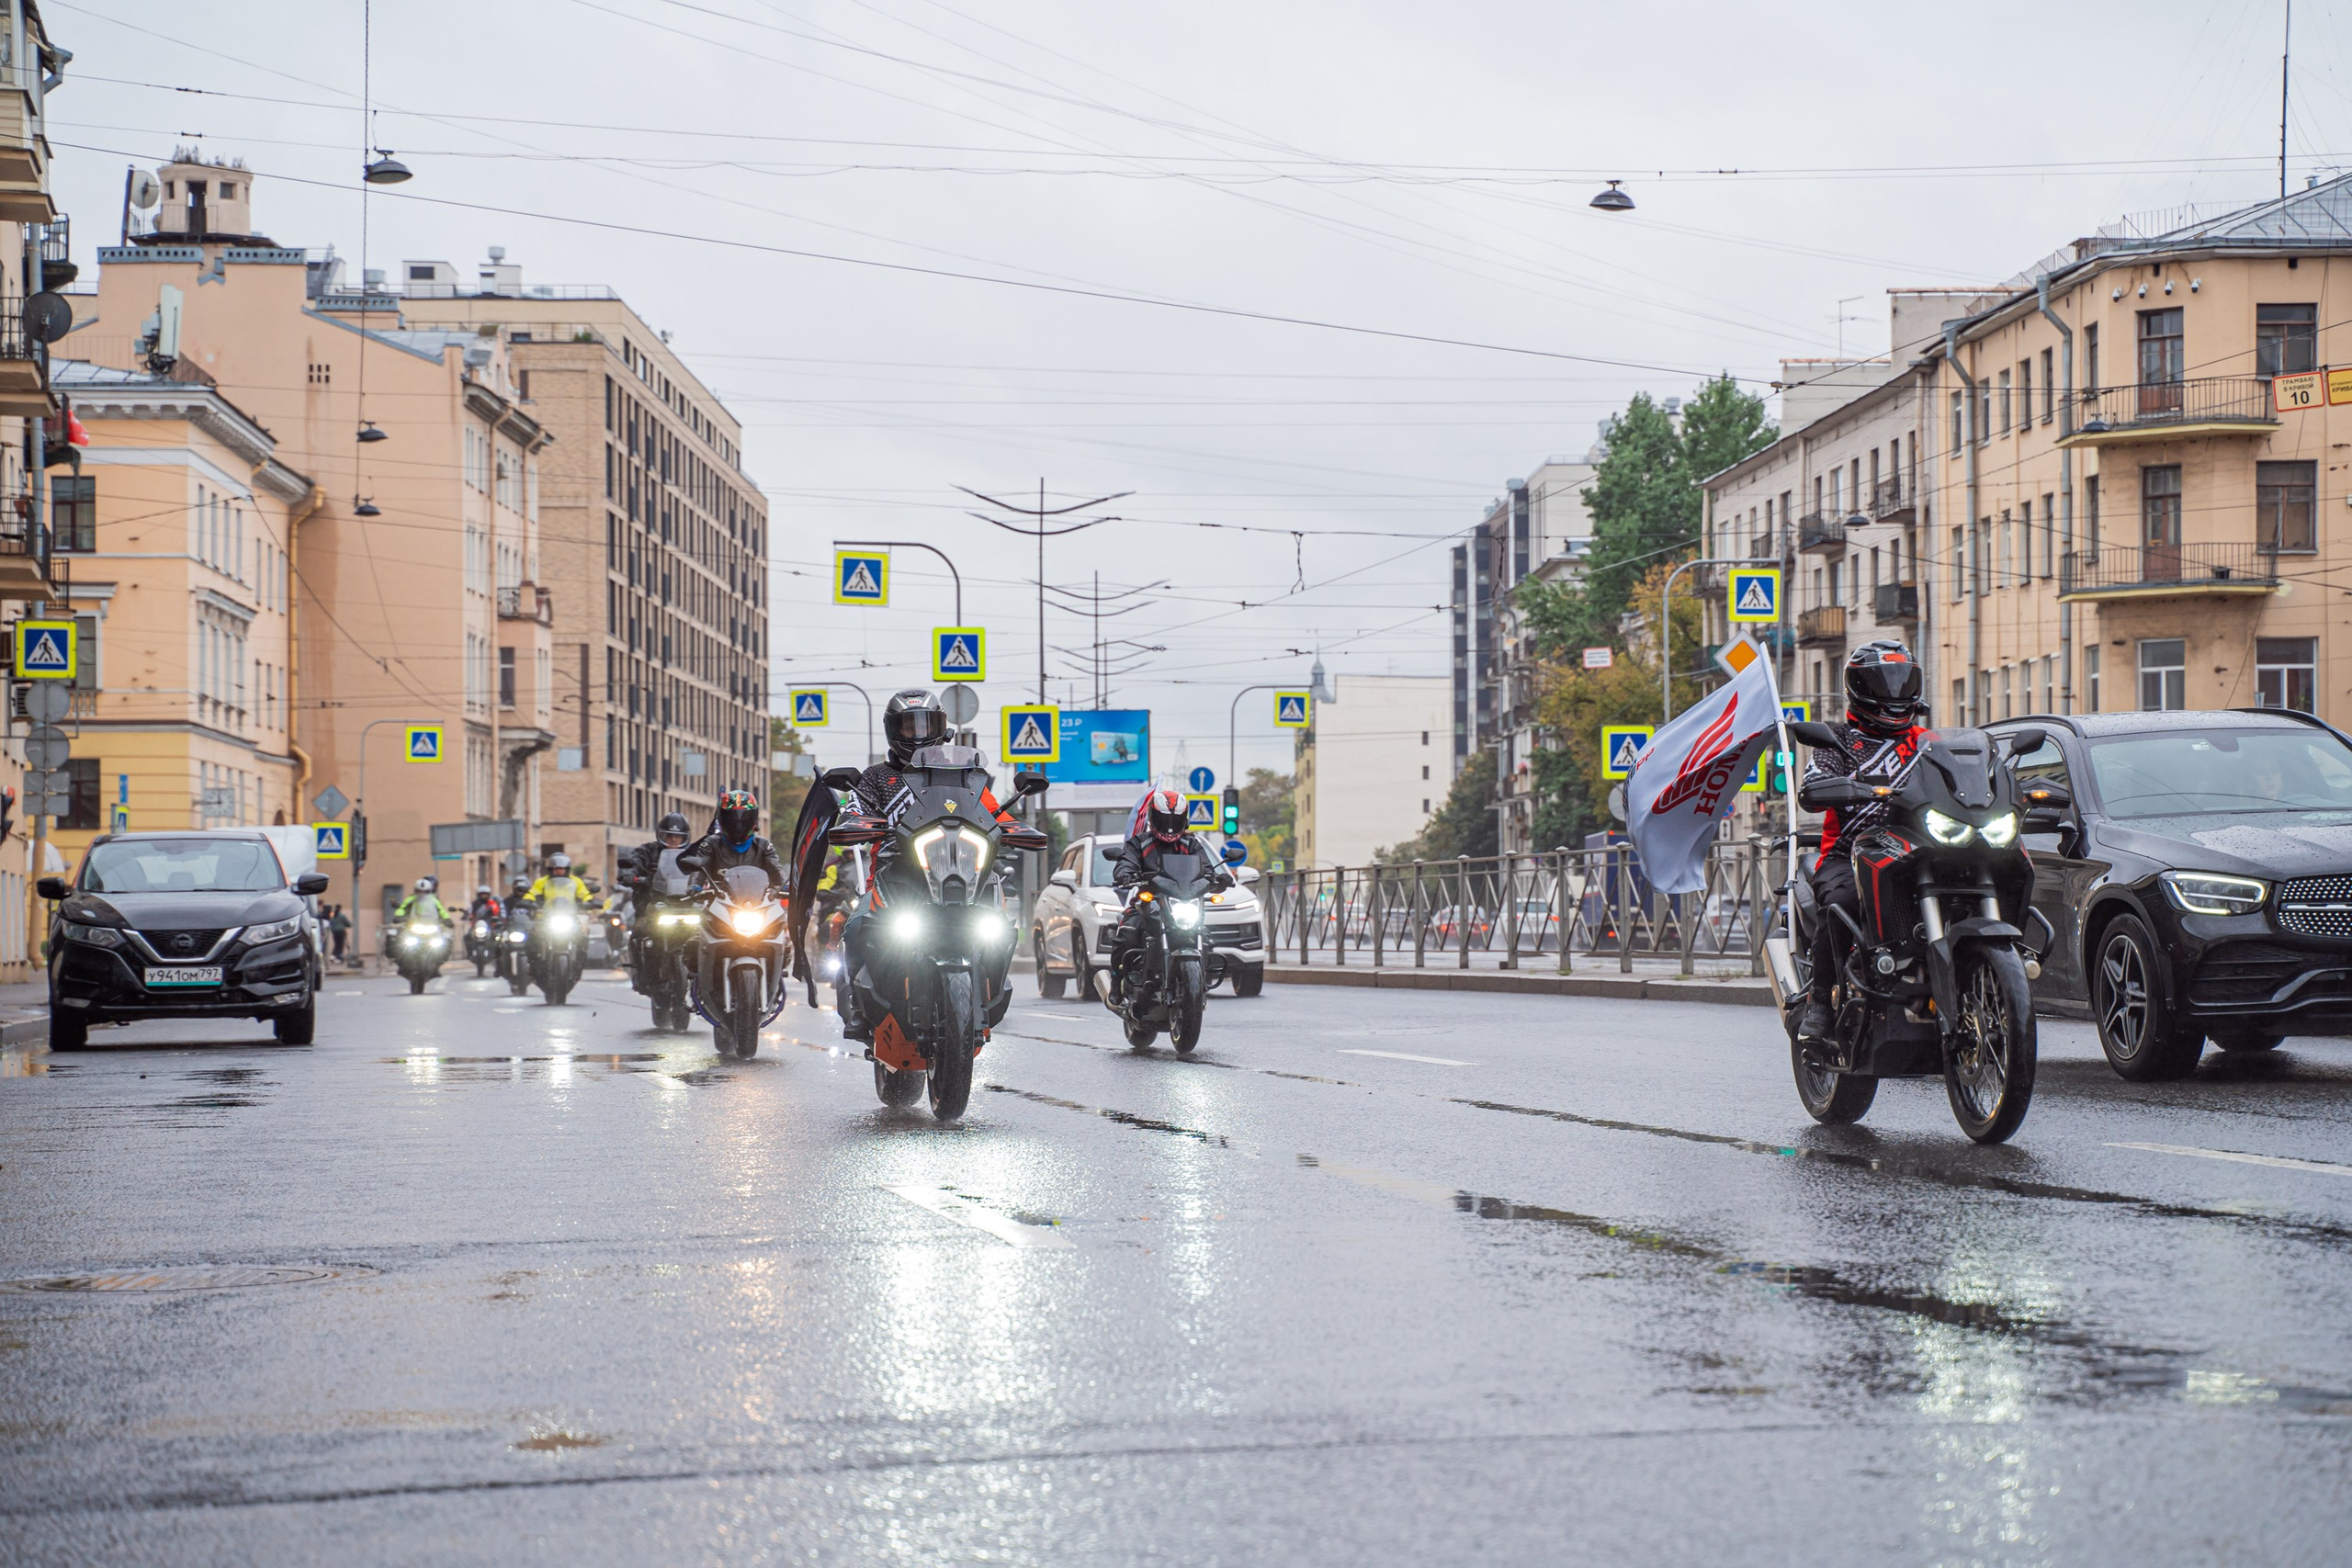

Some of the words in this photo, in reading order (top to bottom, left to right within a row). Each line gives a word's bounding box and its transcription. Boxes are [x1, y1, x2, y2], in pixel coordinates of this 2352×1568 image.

[2282, 376, 2314, 385] ТРАМВАЮ
[2289, 383, 2314, 391] КРИВОЙ
[2290, 390, 2310, 405] 10
[199, 968, 219, 978] 797
